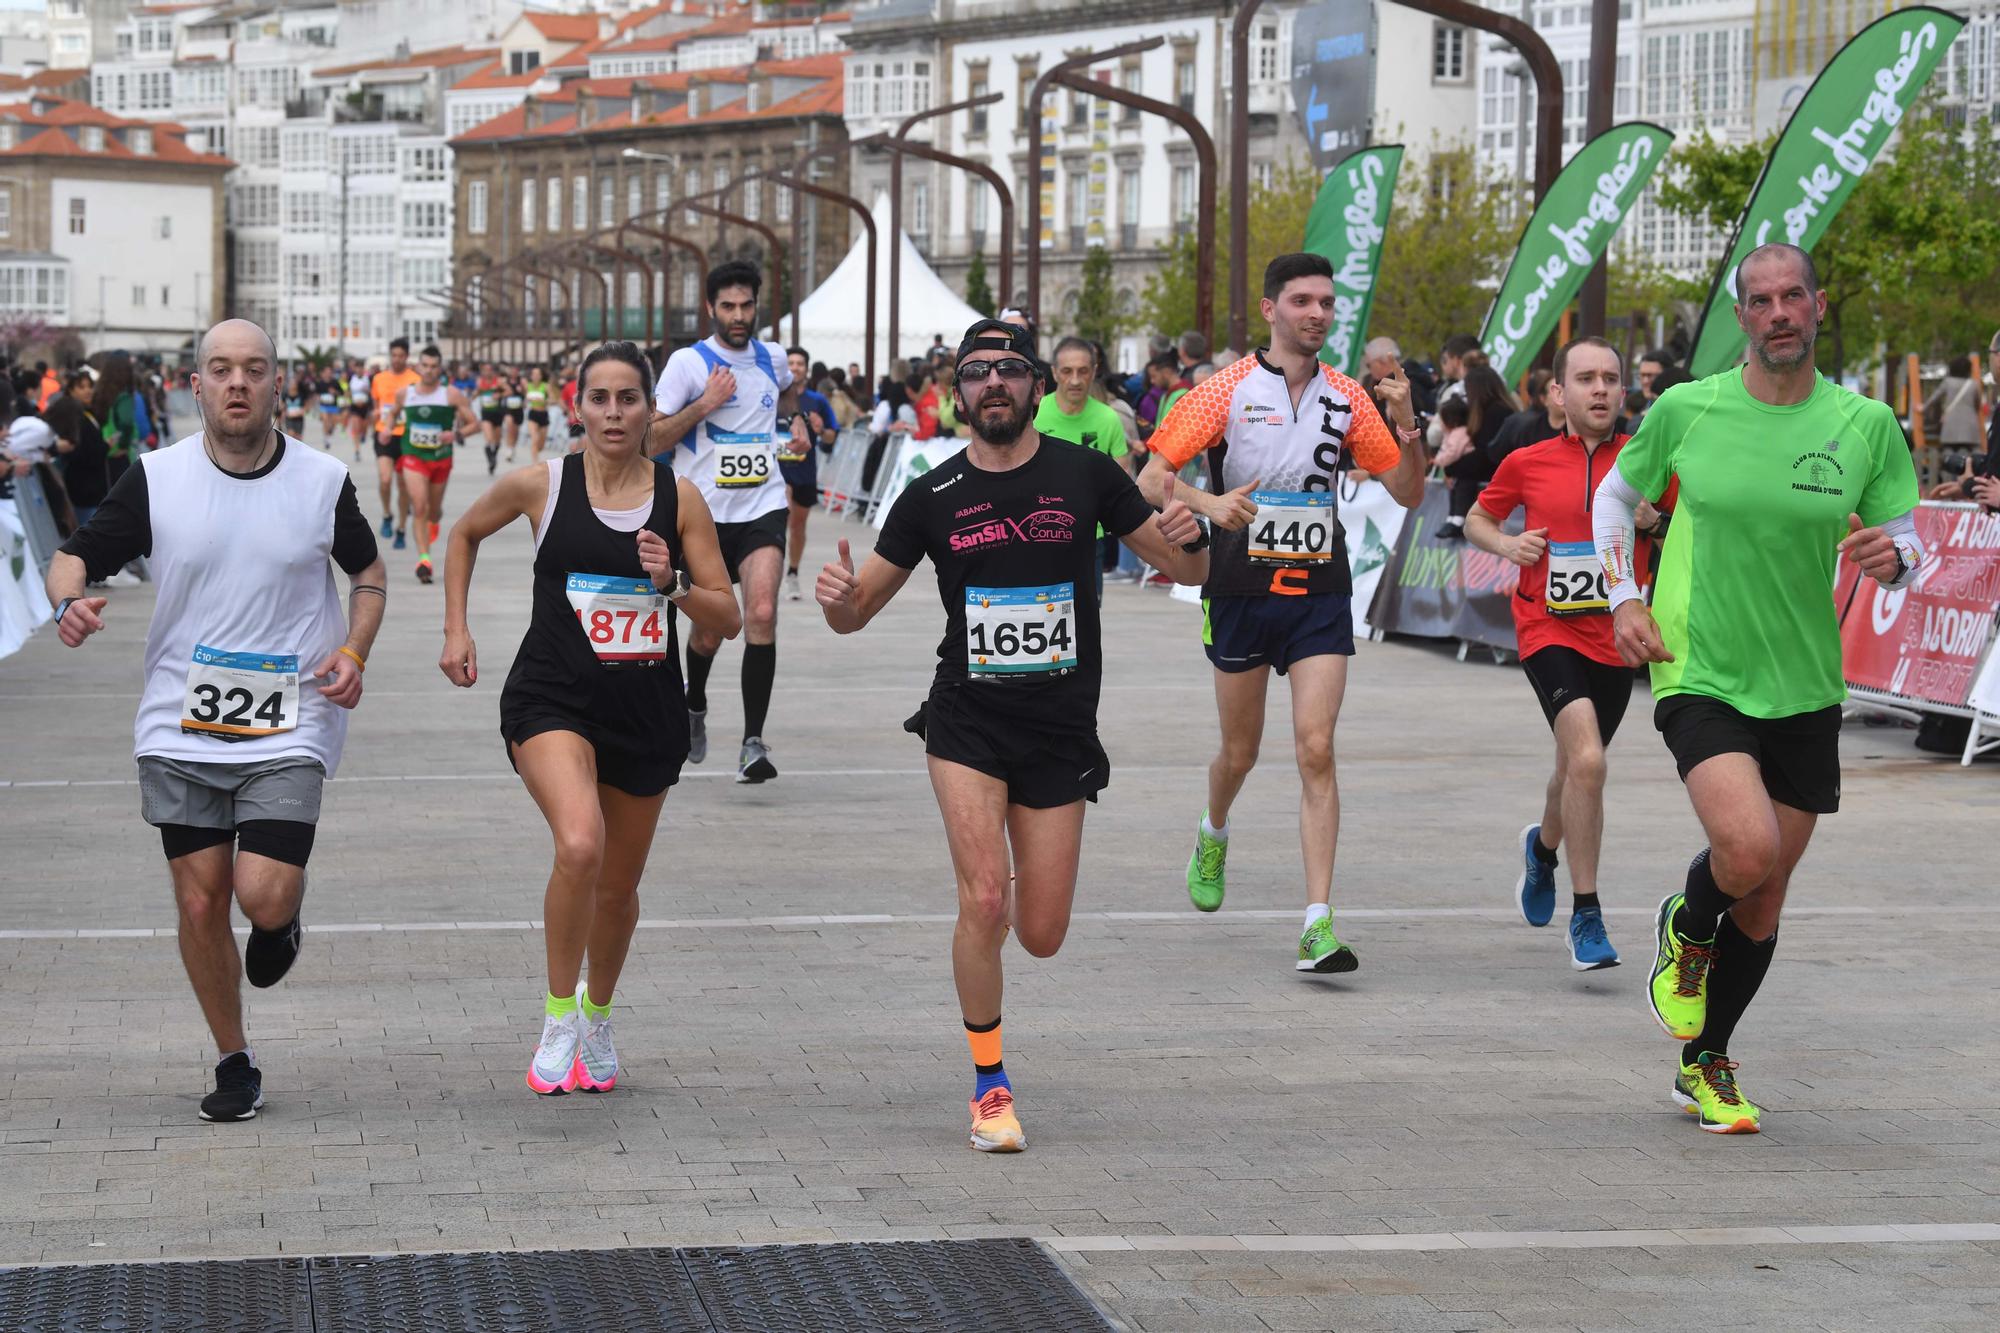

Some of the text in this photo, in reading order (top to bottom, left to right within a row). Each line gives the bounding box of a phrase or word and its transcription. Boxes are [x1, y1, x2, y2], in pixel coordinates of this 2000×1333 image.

[720, 454, 769, 477] 593
[949, 523, 1009, 550] SanSil
[1029, 526, 1073, 540] Coruña
[1255, 520, 1327, 553] 440
[970, 617, 1072, 657] 1654
[190, 683, 286, 728] 324
